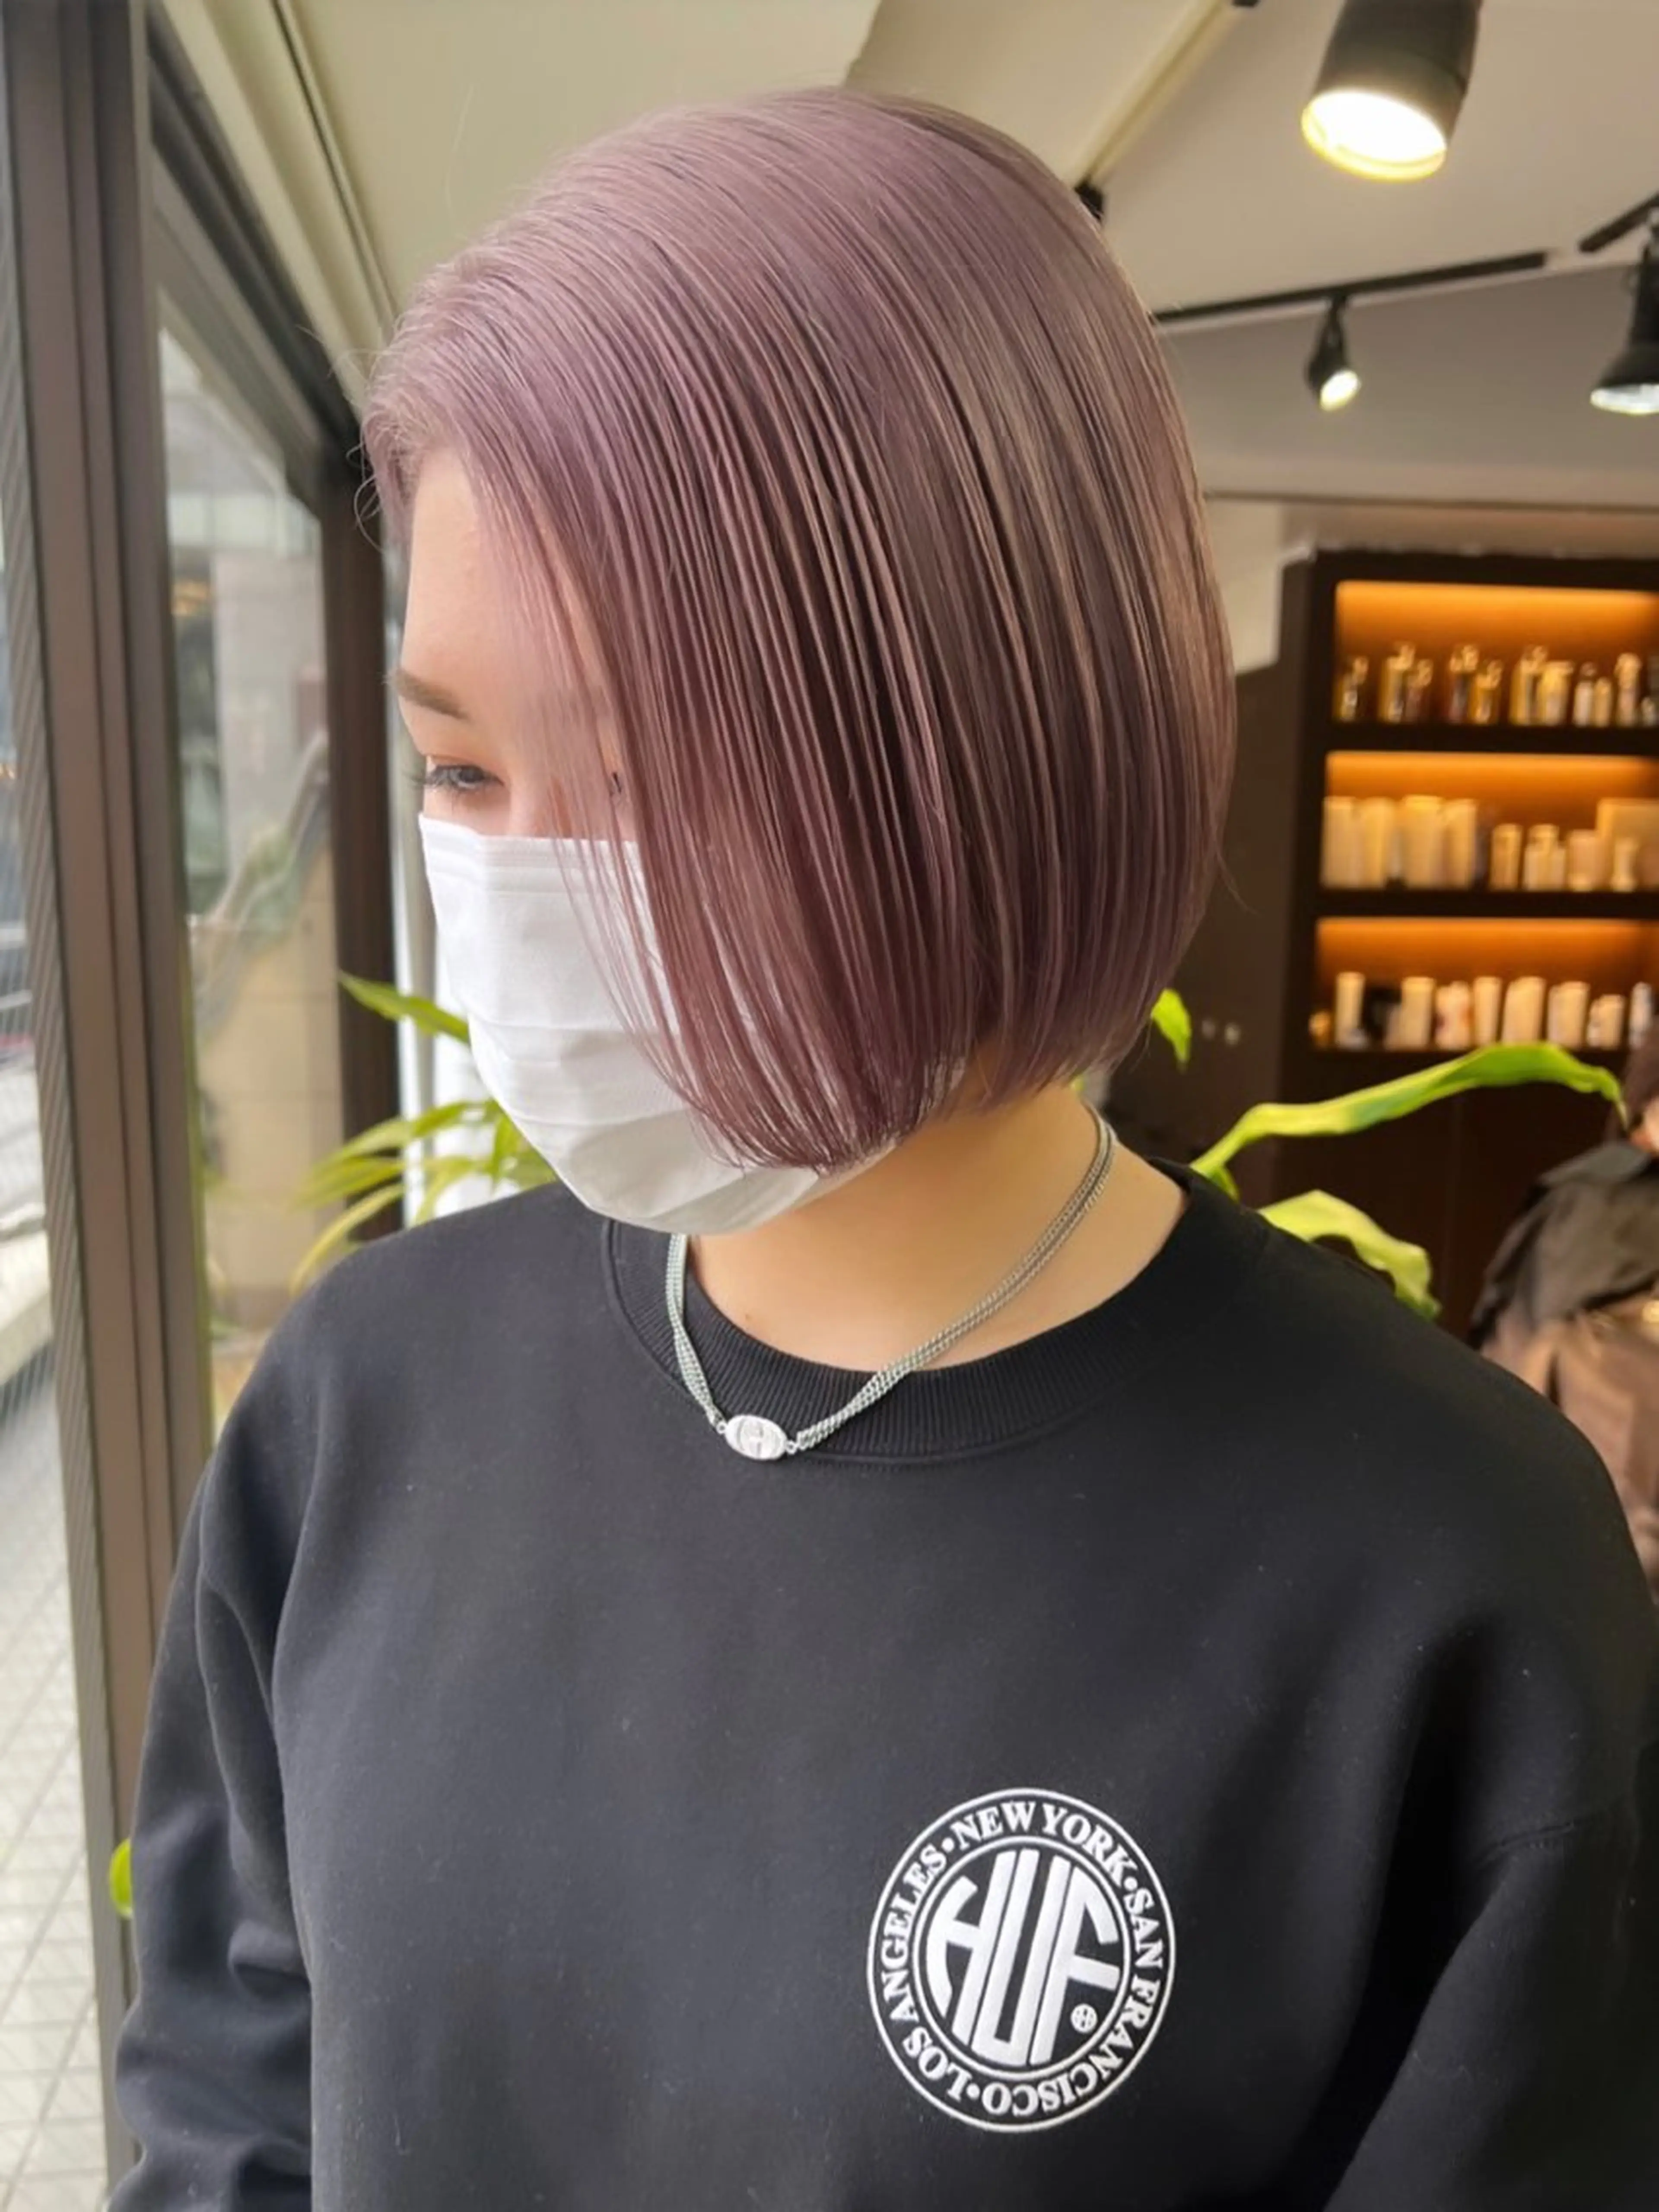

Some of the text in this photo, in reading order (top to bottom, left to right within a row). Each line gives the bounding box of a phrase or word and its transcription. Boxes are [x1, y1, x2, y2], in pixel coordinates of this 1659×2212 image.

[950, 1801, 1138, 1887] NEW YORK
[880, 1843, 972, 2101] LOS ANGELES
[925, 1848, 1120, 2066] HUF
[982, 1888, 1163, 2116] SAN FRANCISCO
